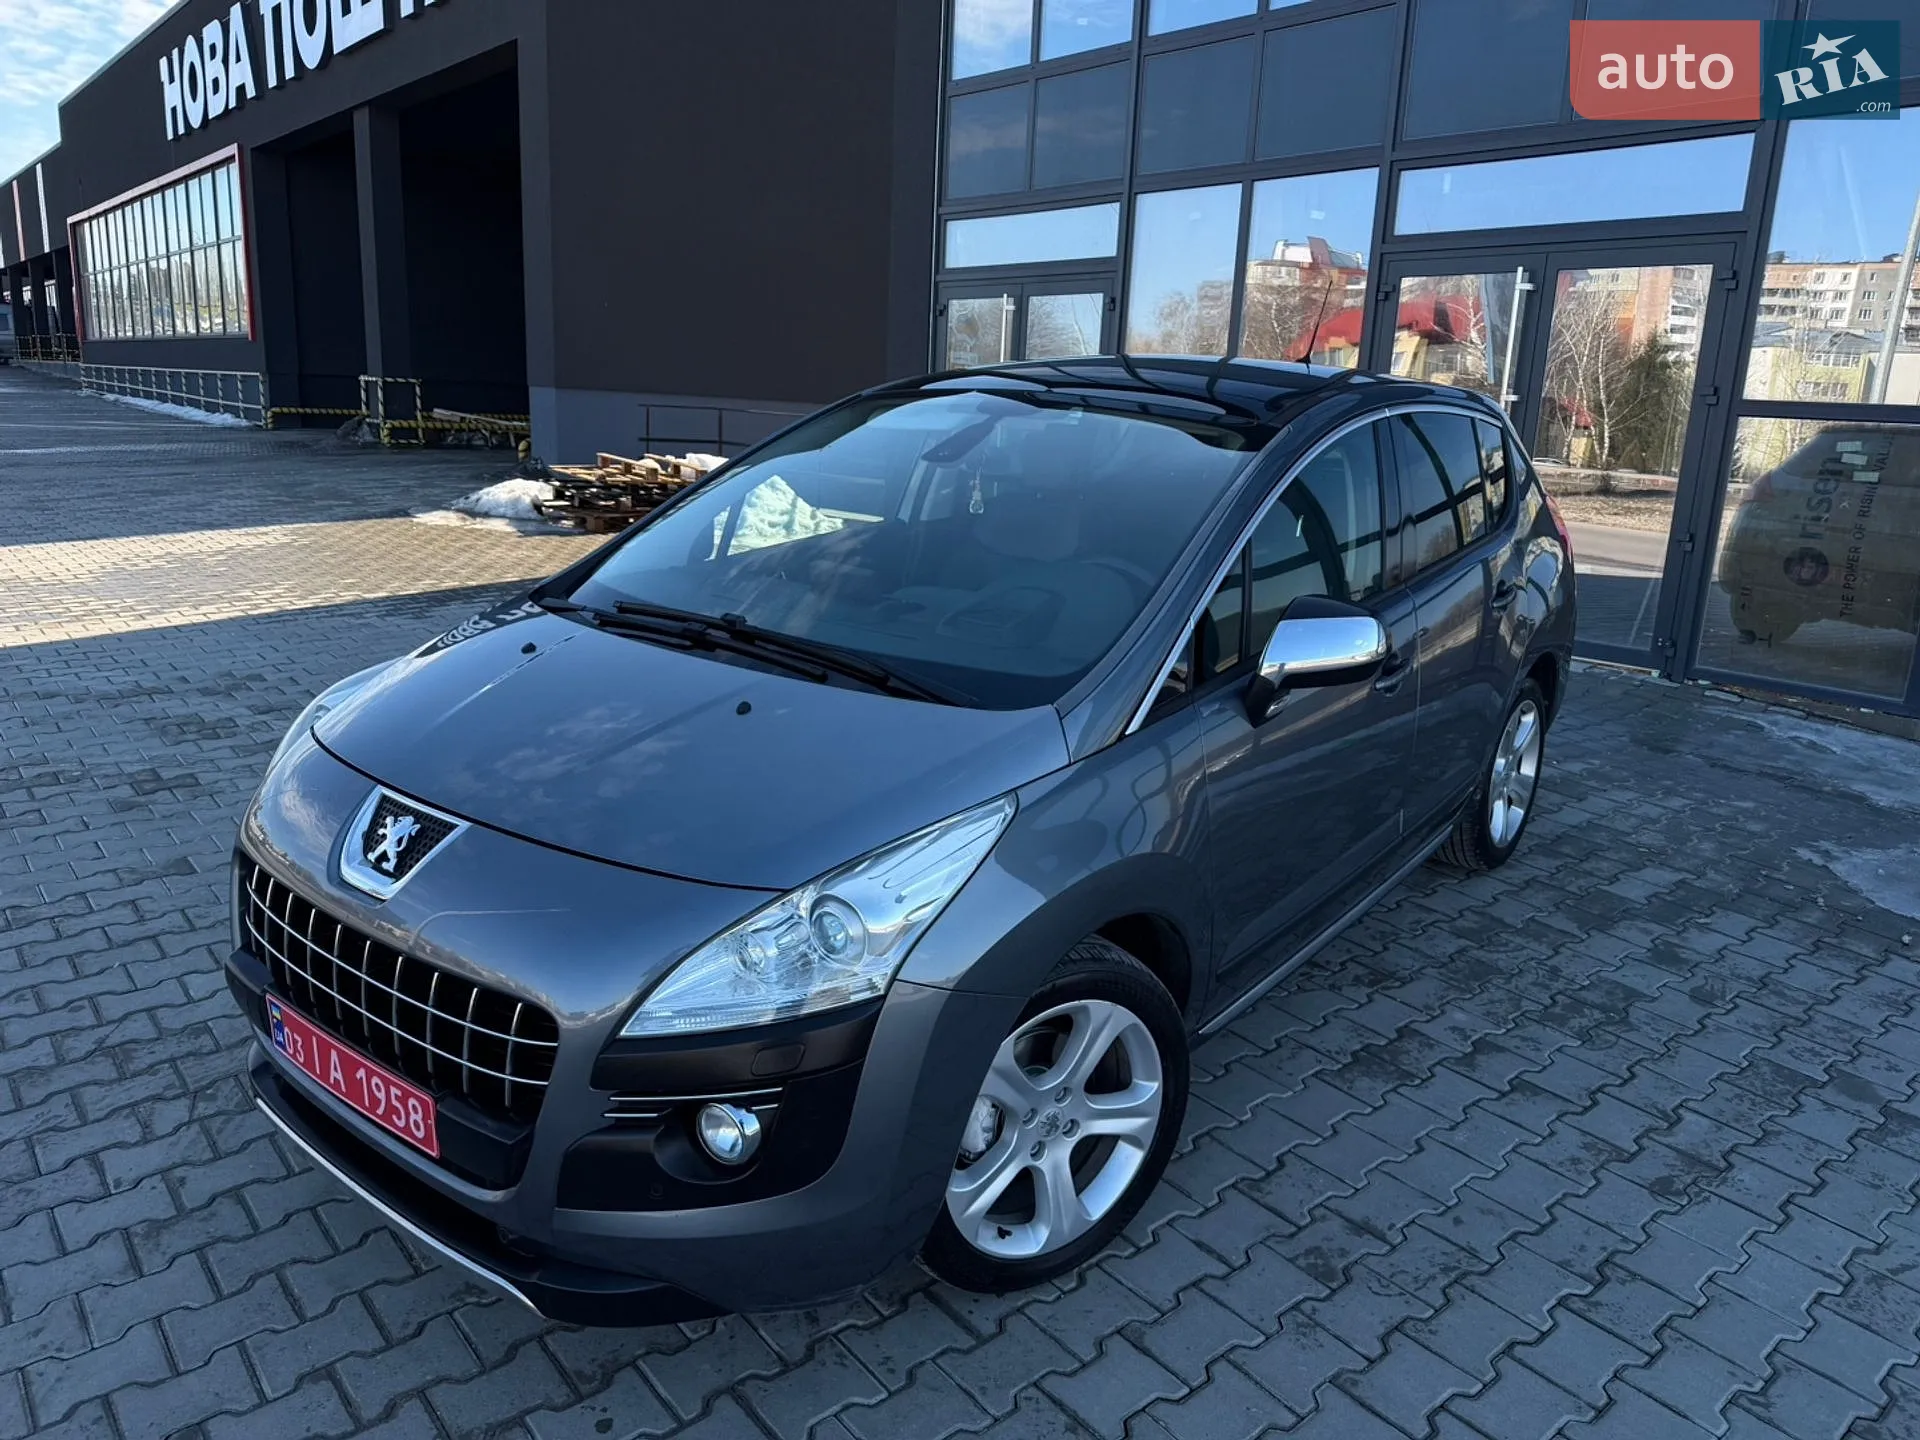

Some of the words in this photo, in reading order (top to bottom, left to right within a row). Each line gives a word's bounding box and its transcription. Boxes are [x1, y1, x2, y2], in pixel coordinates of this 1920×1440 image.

[159, 2, 256, 140] НОВА
[1852, 523, 1866, 540] OF
[1842, 546, 1862, 590] POWER
[1839, 594, 1855, 618] THE
[284, 1026, 304, 1064] 03
[355, 1067, 425, 1140] 1958
